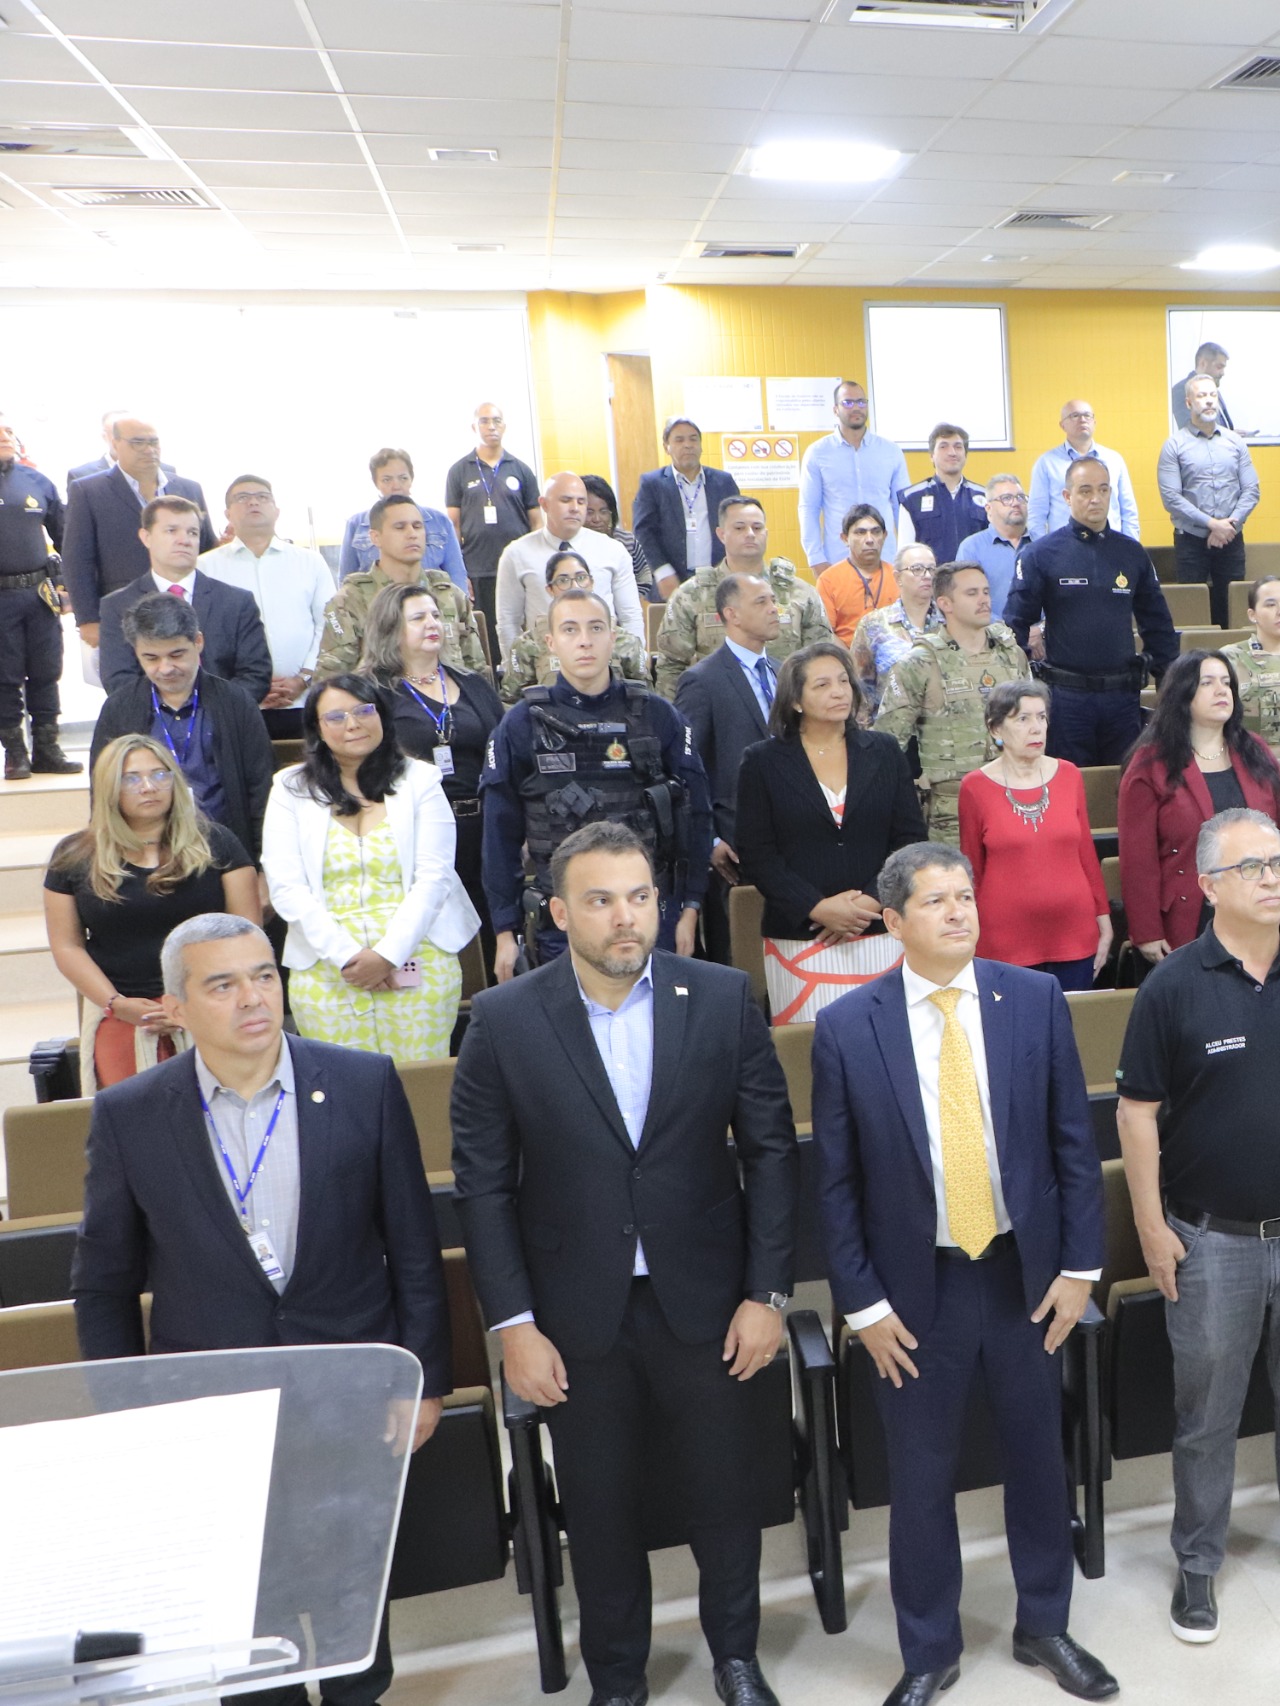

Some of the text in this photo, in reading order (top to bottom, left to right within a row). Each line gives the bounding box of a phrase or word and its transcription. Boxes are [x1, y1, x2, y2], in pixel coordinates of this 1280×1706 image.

[327, 611, 345, 635] PMDF
[890, 670, 900, 697] PMDF
[488, 739, 497, 770] PMDF
[1205, 1036, 1246, 1049] ALCEU PRESTES
[1207, 1042, 1246, 1055] ADMINISTRADOR
